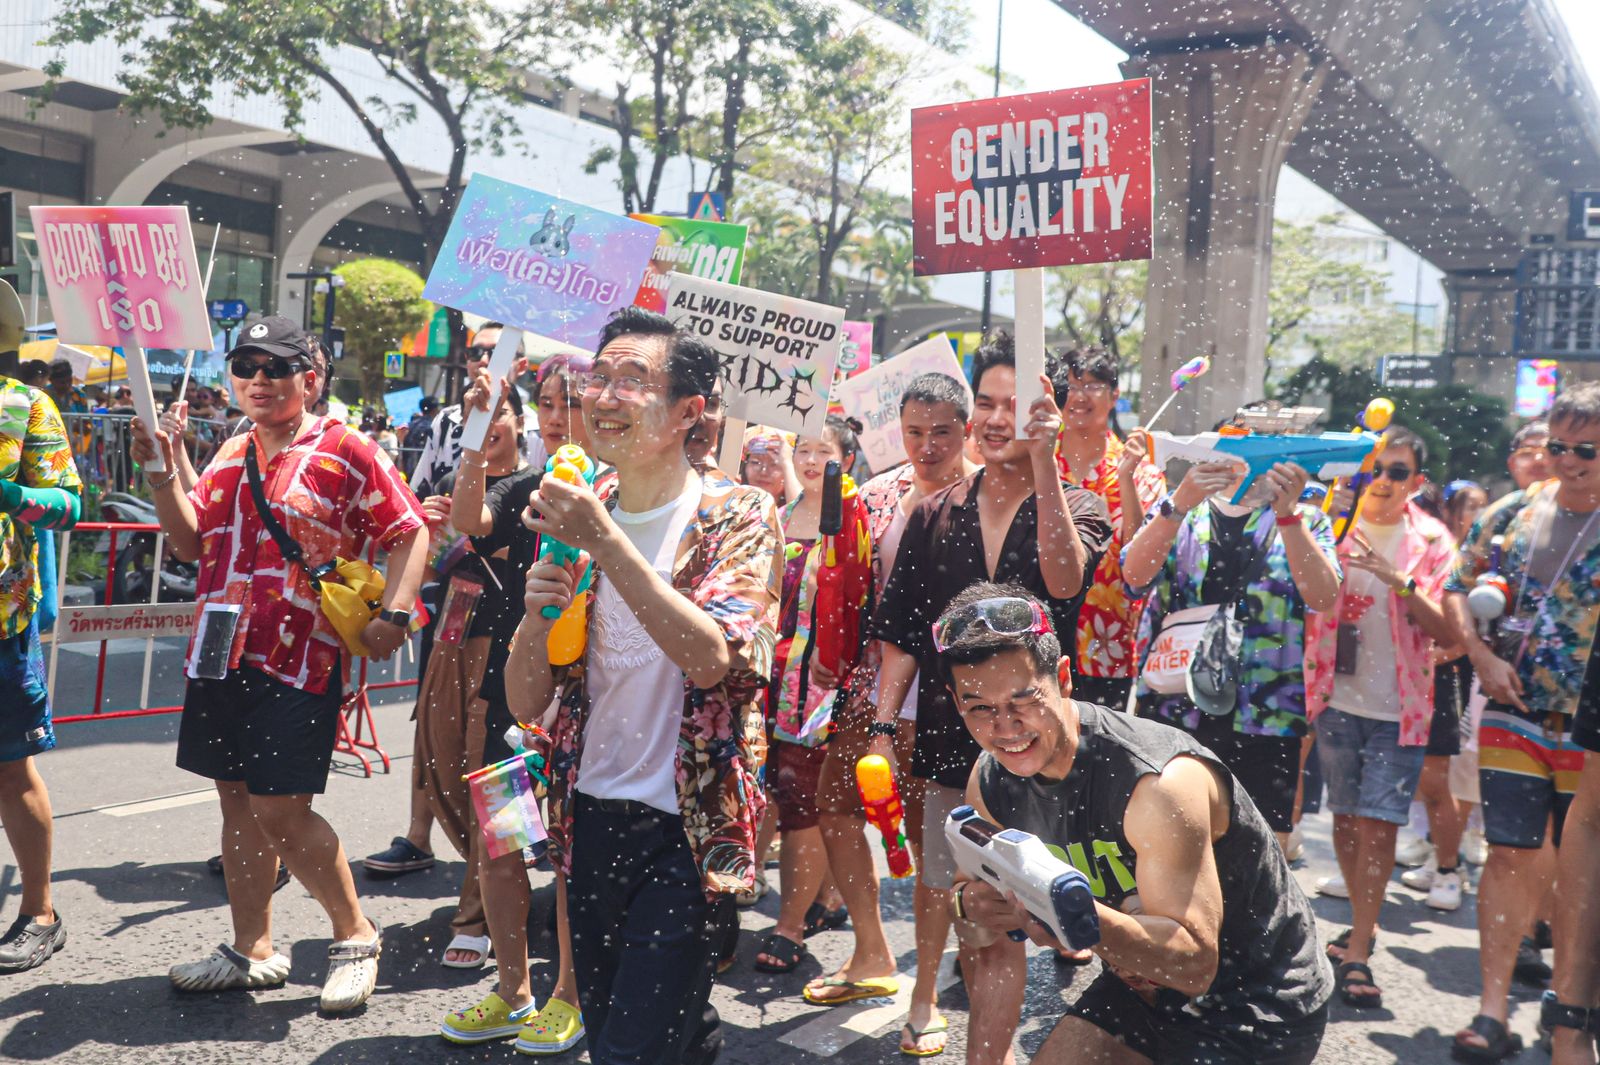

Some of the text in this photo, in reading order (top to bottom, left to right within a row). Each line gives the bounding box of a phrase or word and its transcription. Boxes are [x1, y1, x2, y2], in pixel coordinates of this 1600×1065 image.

[950, 112, 1109, 182] GENDER
[934, 174, 1131, 246] EQUALITY
[45, 223, 188, 291] BORN TO BE
[673, 290, 836, 341] ALWAYS PROUD
[688, 315, 714, 336] TO
[718, 323, 819, 360] SUPPORT
[712, 348, 817, 427] RIDE
